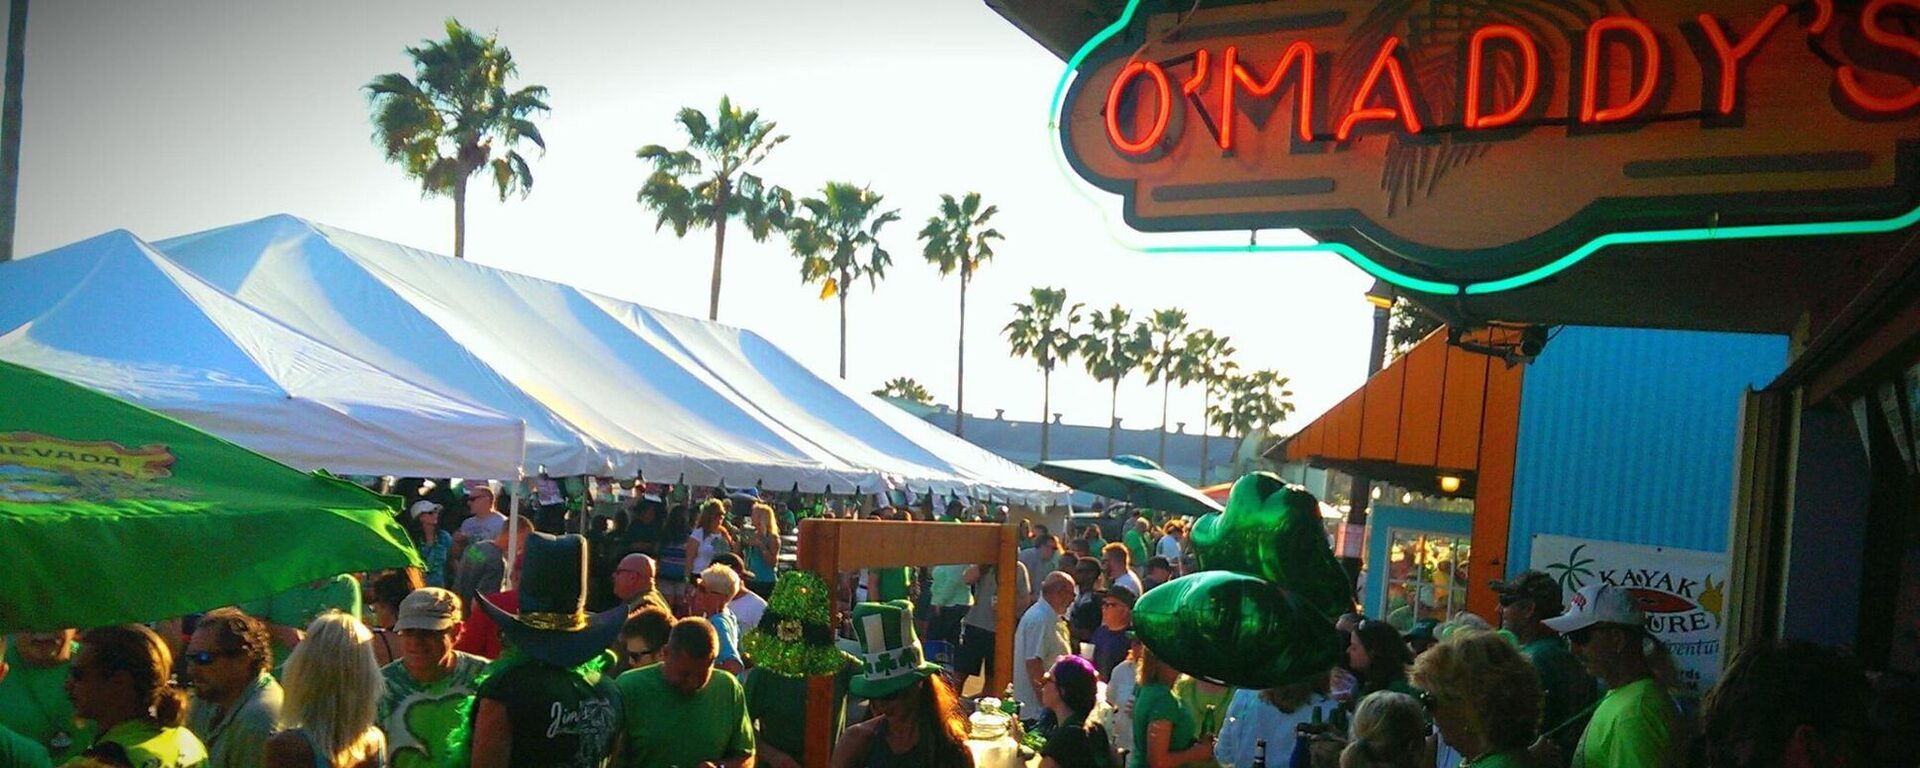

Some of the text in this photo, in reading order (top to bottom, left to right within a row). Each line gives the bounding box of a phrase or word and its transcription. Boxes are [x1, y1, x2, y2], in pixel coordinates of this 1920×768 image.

[1104, 0, 1920, 153] O'MADDY'S
[0, 445, 121, 467] EVADA
[1598, 569, 1698, 599] KAYAK
[1647, 612, 1711, 634] URE
